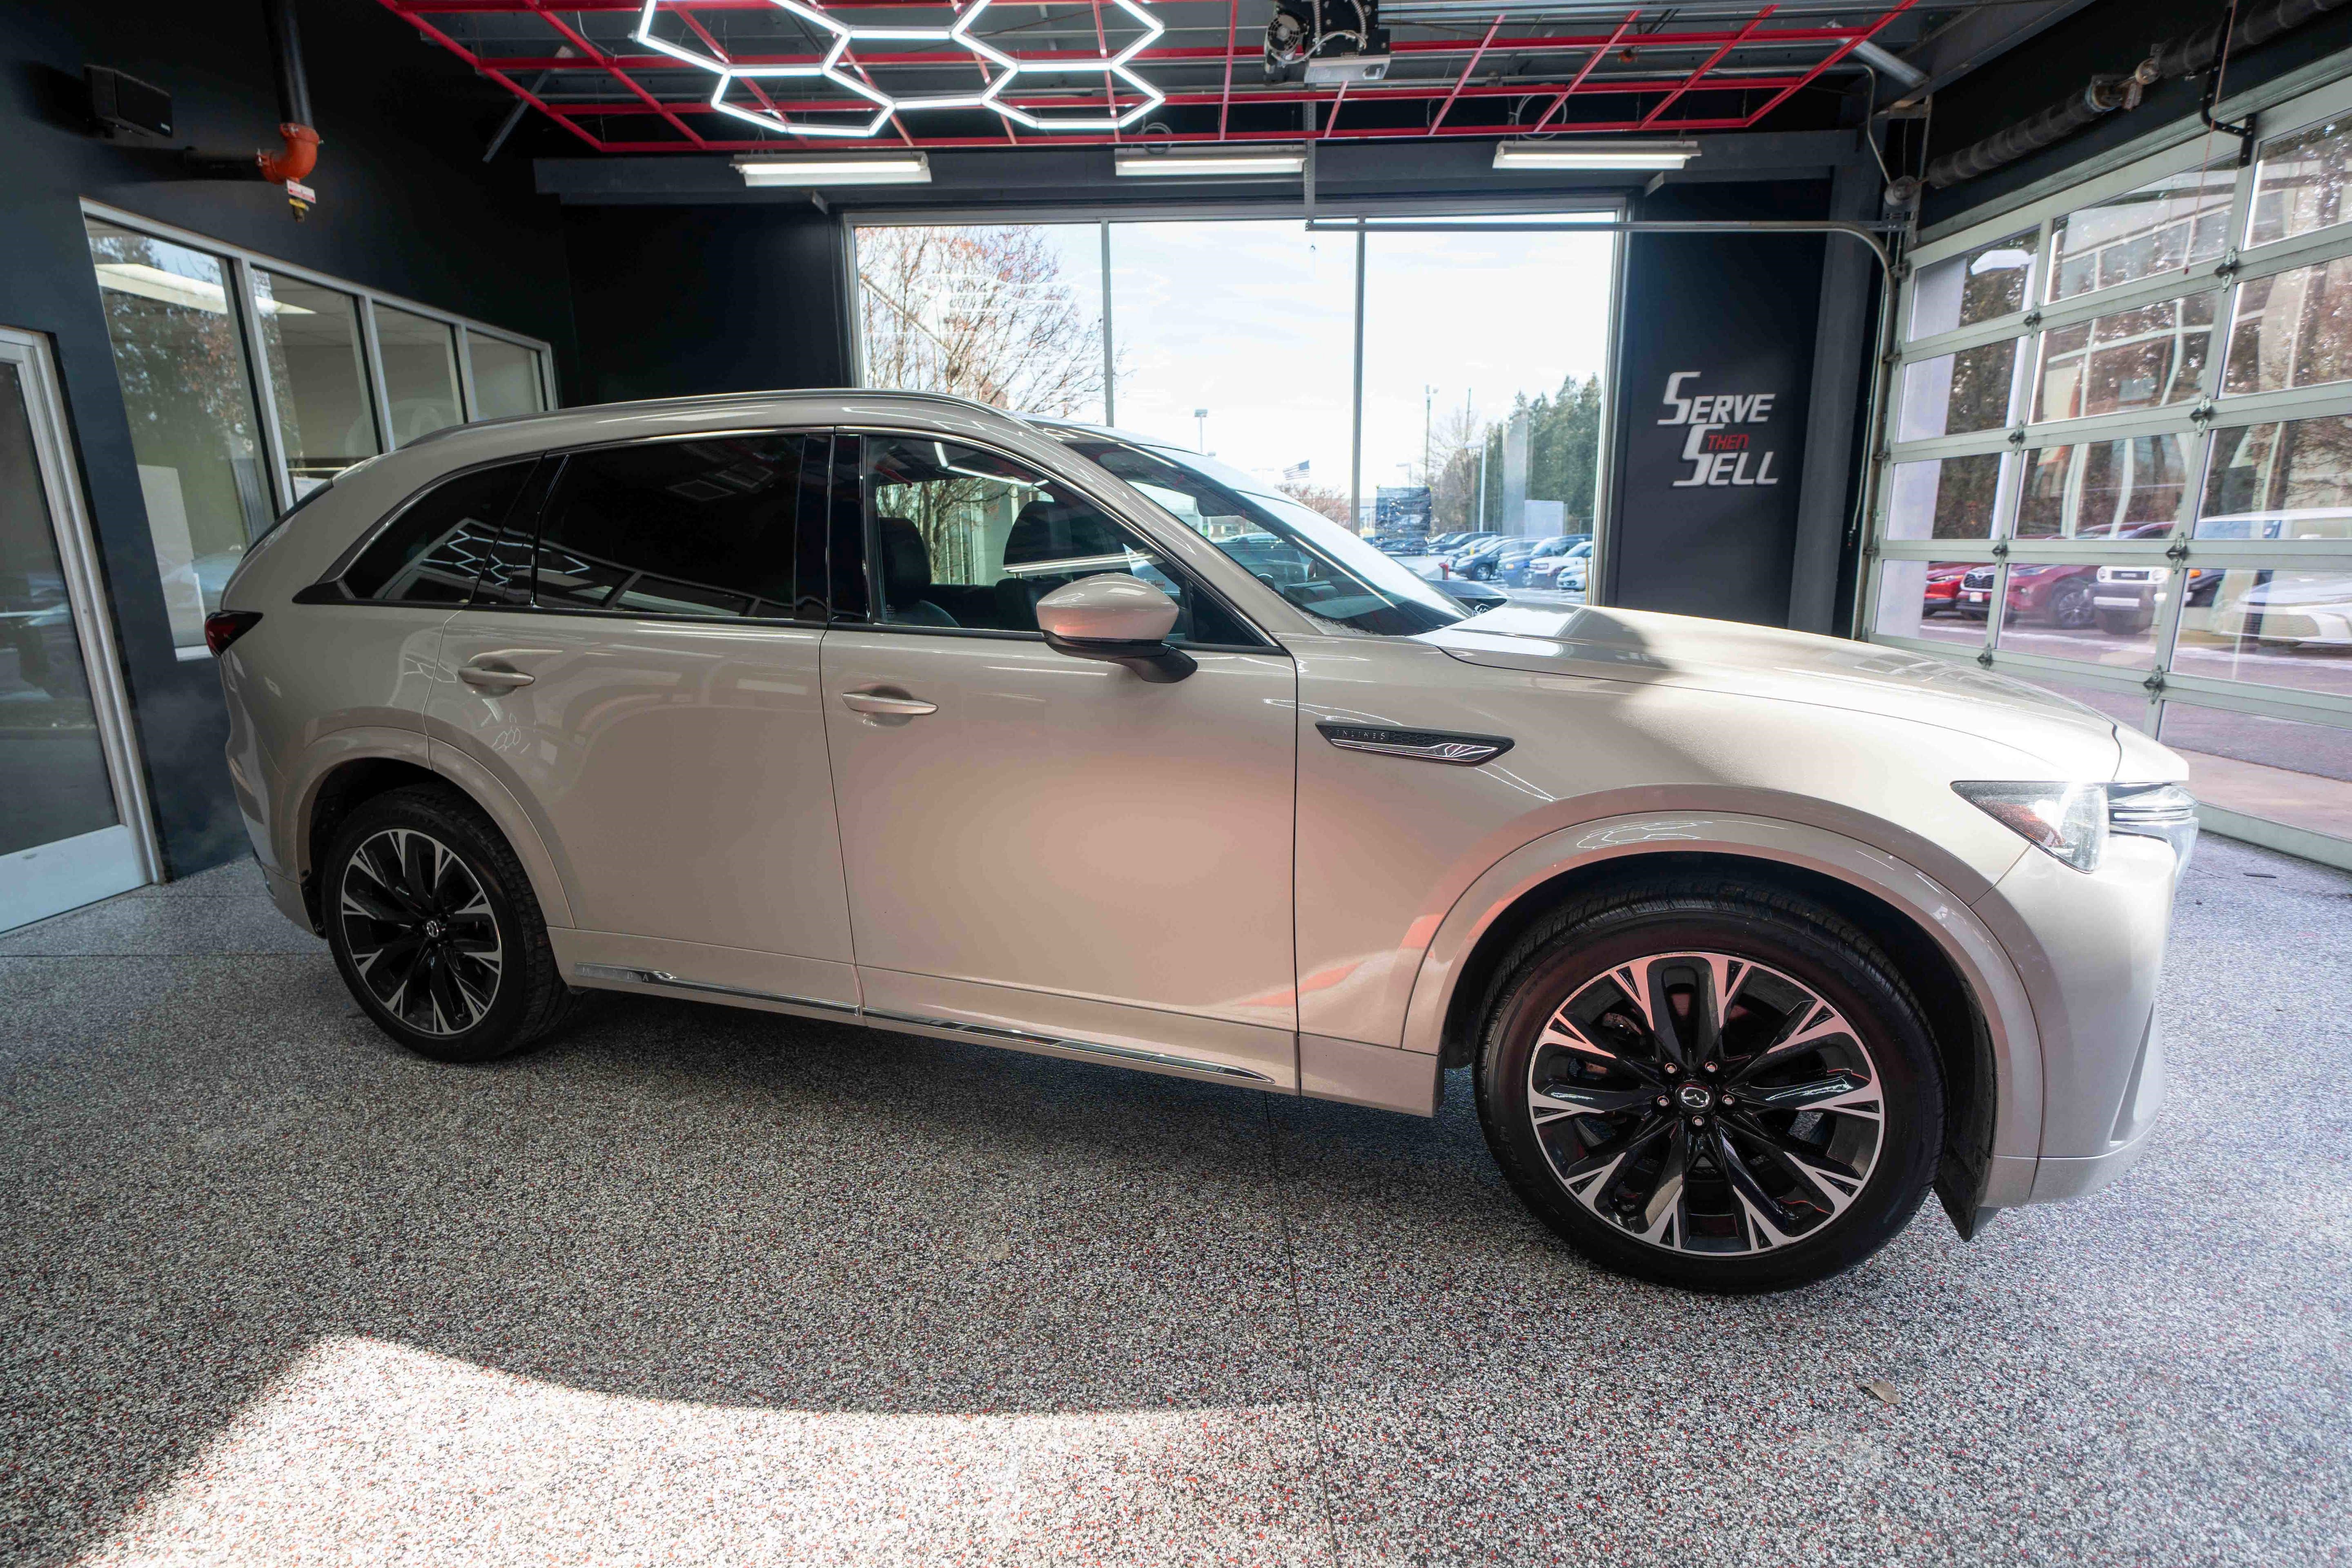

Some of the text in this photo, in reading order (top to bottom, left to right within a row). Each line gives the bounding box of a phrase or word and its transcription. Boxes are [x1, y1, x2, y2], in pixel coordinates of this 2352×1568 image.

[1657, 372, 1776, 425] SERVE
[1672, 423, 1778, 487] SELL
[1708, 434, 1749, 450] THEN
